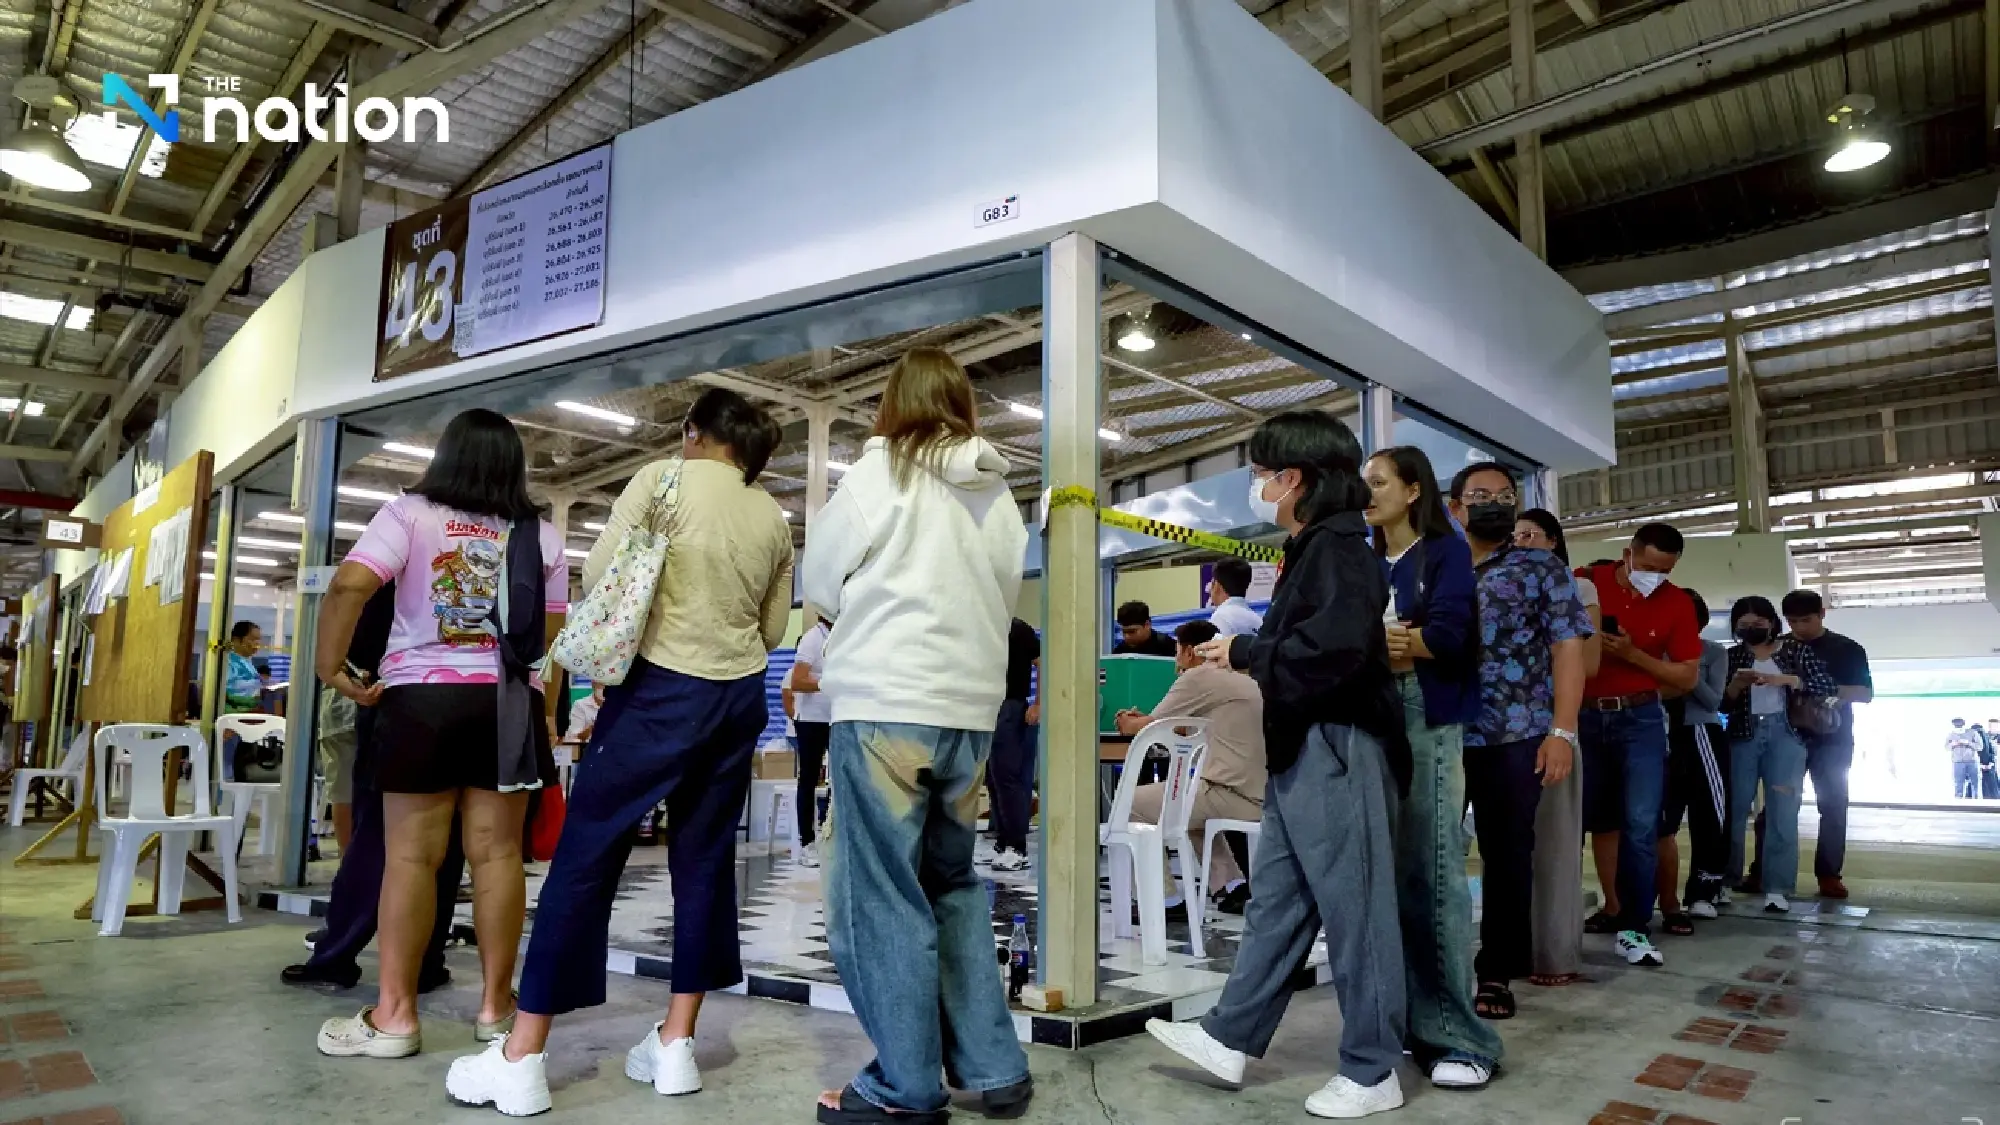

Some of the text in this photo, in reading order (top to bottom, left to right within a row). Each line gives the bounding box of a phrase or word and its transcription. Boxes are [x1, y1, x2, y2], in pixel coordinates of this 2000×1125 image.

[412, 214, 442, 254] ชุดที่
[385, 249, 456, 347] 43
